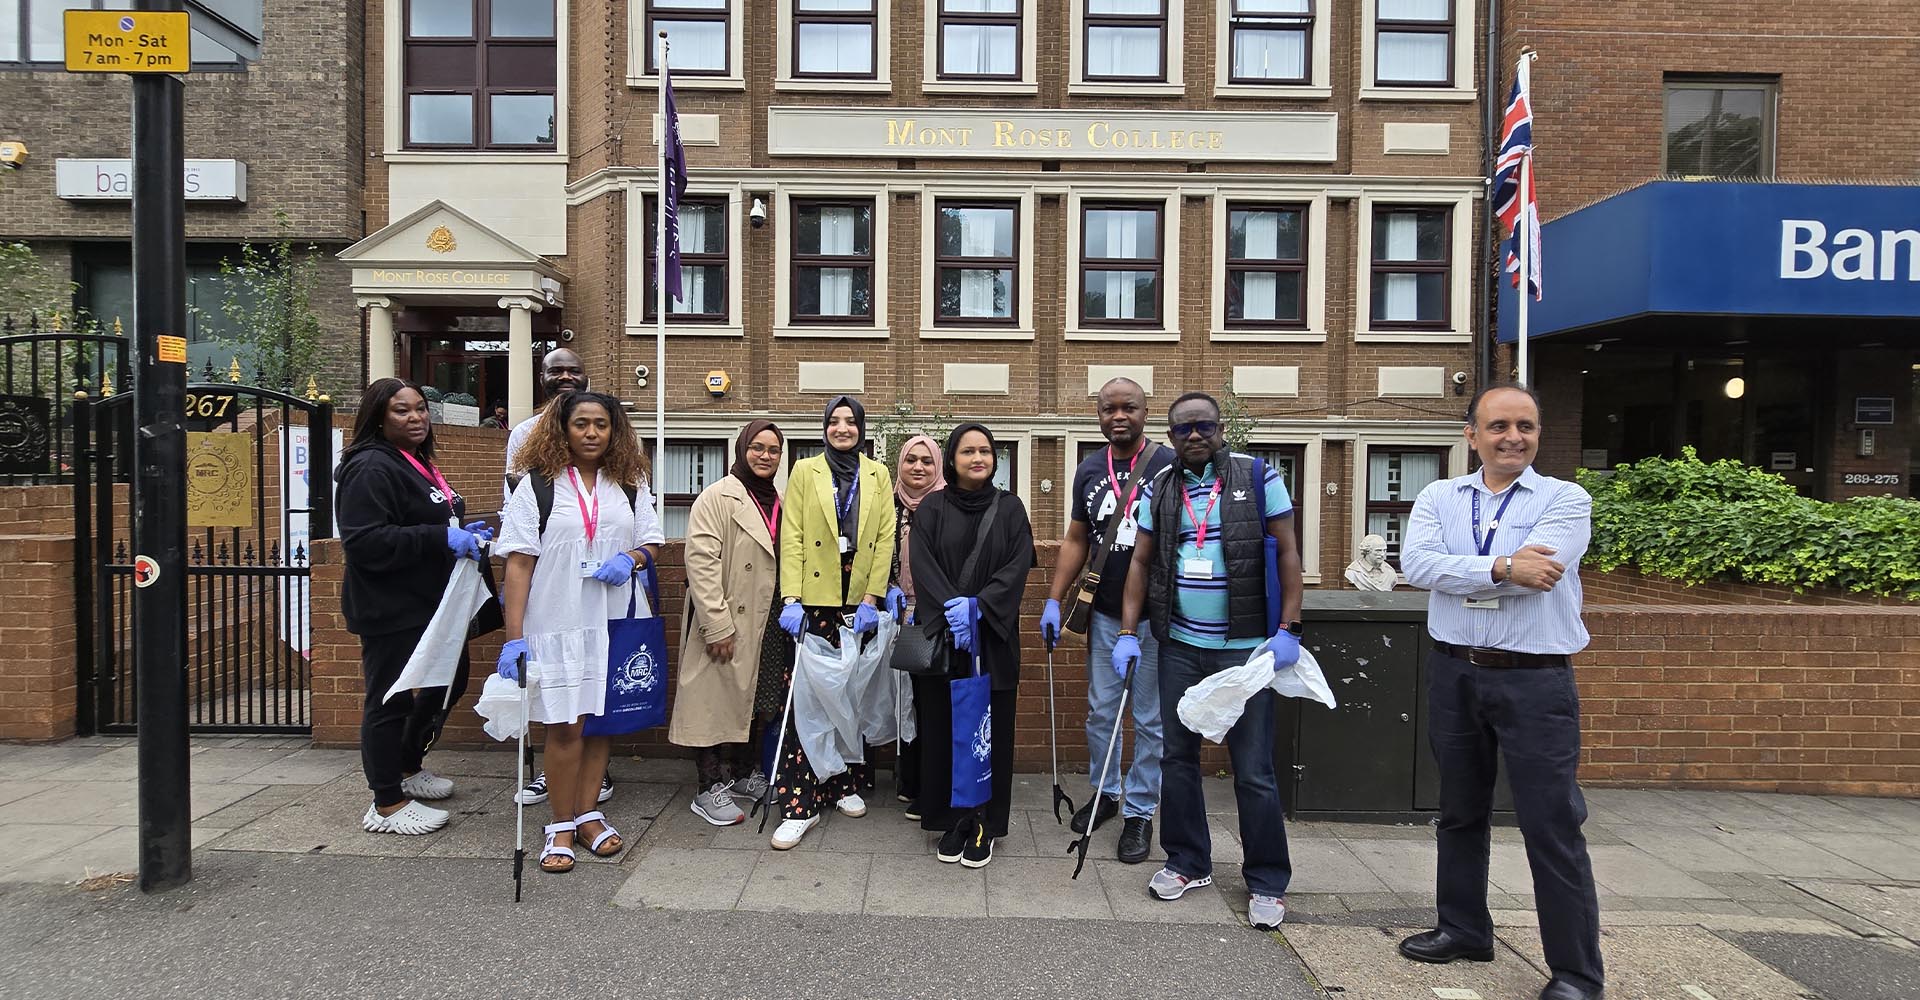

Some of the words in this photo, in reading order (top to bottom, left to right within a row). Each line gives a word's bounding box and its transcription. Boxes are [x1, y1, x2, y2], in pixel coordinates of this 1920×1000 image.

[88, 33, 124, 47] Mon
[138, 34, 167, 48] Sat
[884, 119, 973, 147] Mont
[991, 120, 1072, 148] Rose
[1087, 121, 1224, 149] College
[186, 394, 233, 416] 267
[296, 435, 309, 443] DR
[296, 446, 308, 464] B
[1844, 473, 1899, 485] 269-275
[630, 668, 648, 677] MRC
